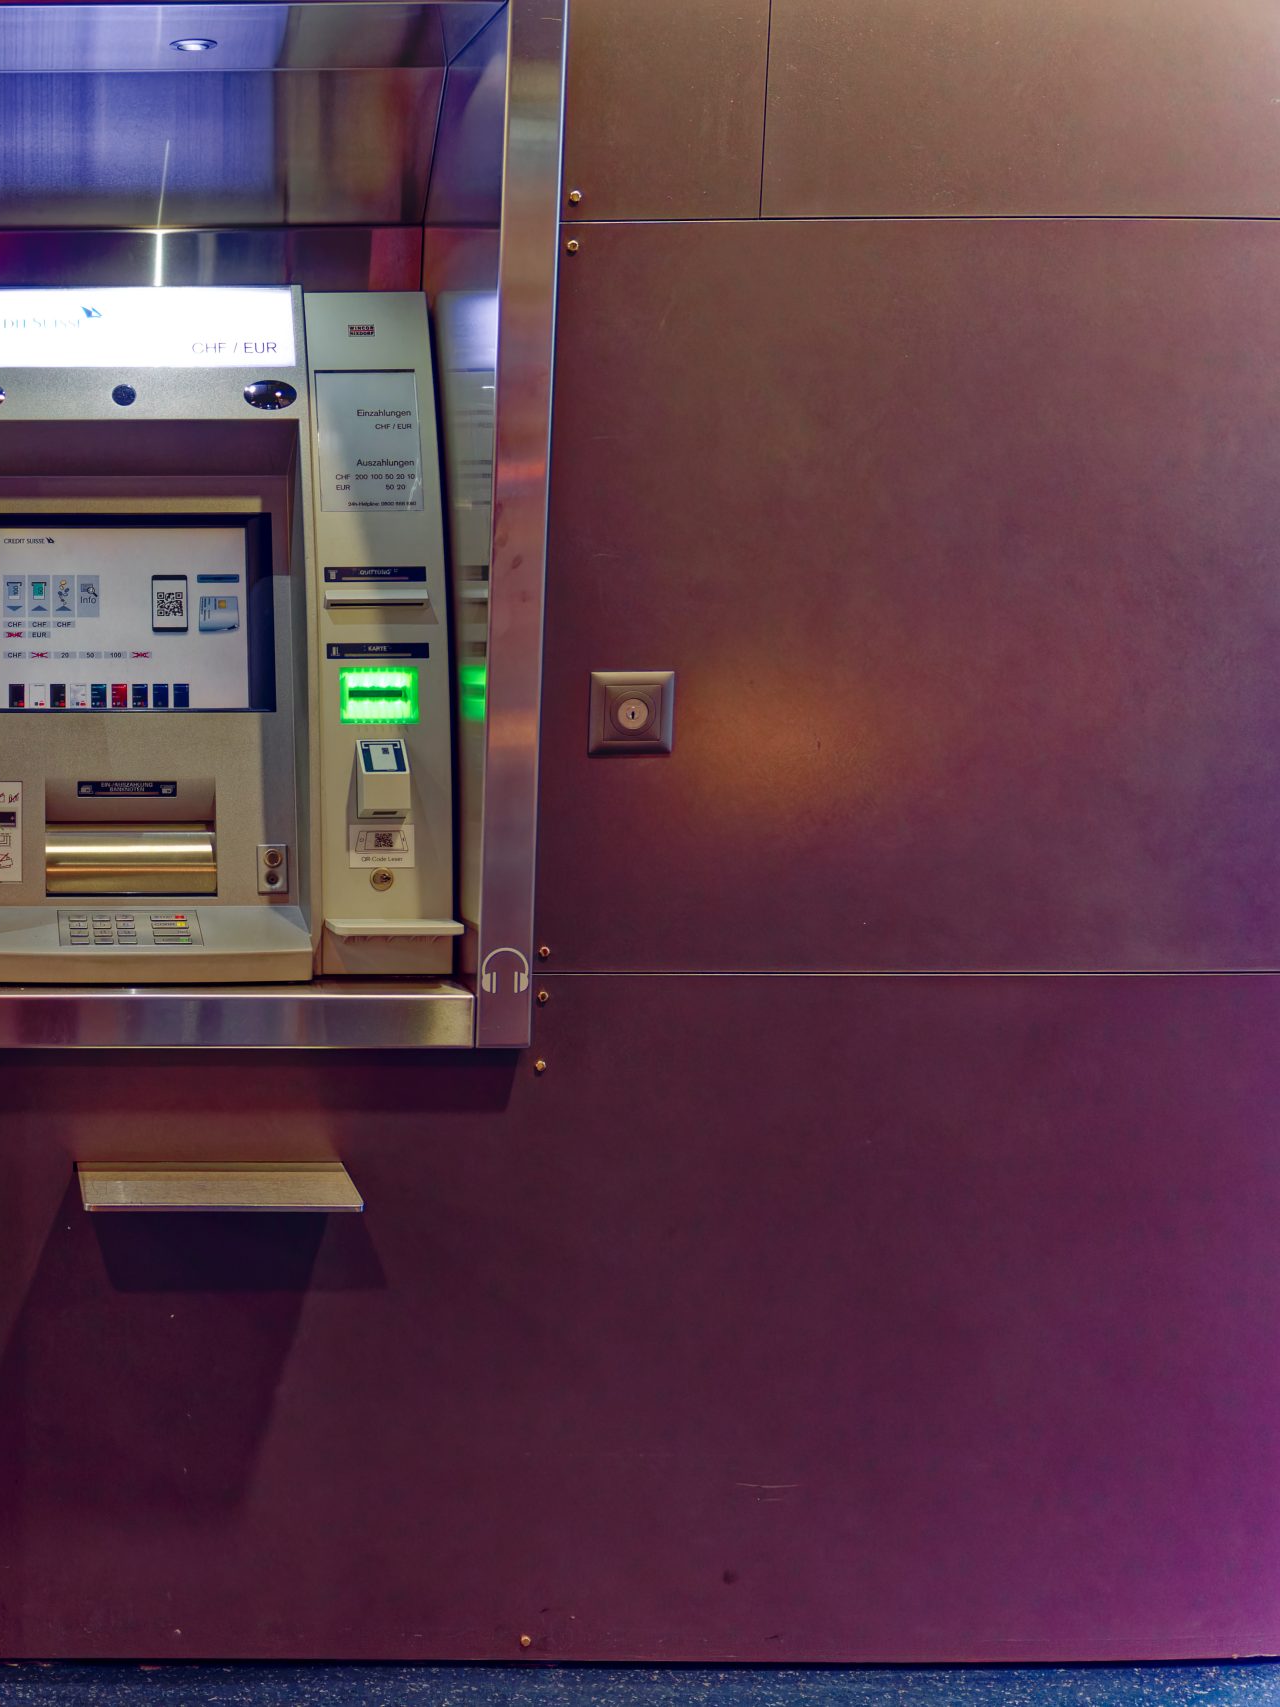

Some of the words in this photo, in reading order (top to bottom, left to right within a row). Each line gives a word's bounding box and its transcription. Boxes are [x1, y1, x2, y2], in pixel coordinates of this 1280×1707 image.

[191, 342, 227, 354] CHF
[243, 342, 278, 354] EUR
[356, 409, 412, 418] Einzahlungen
[356, 459, 415, 468] Auszahlungen
[80, 596, 97, 604] Info
